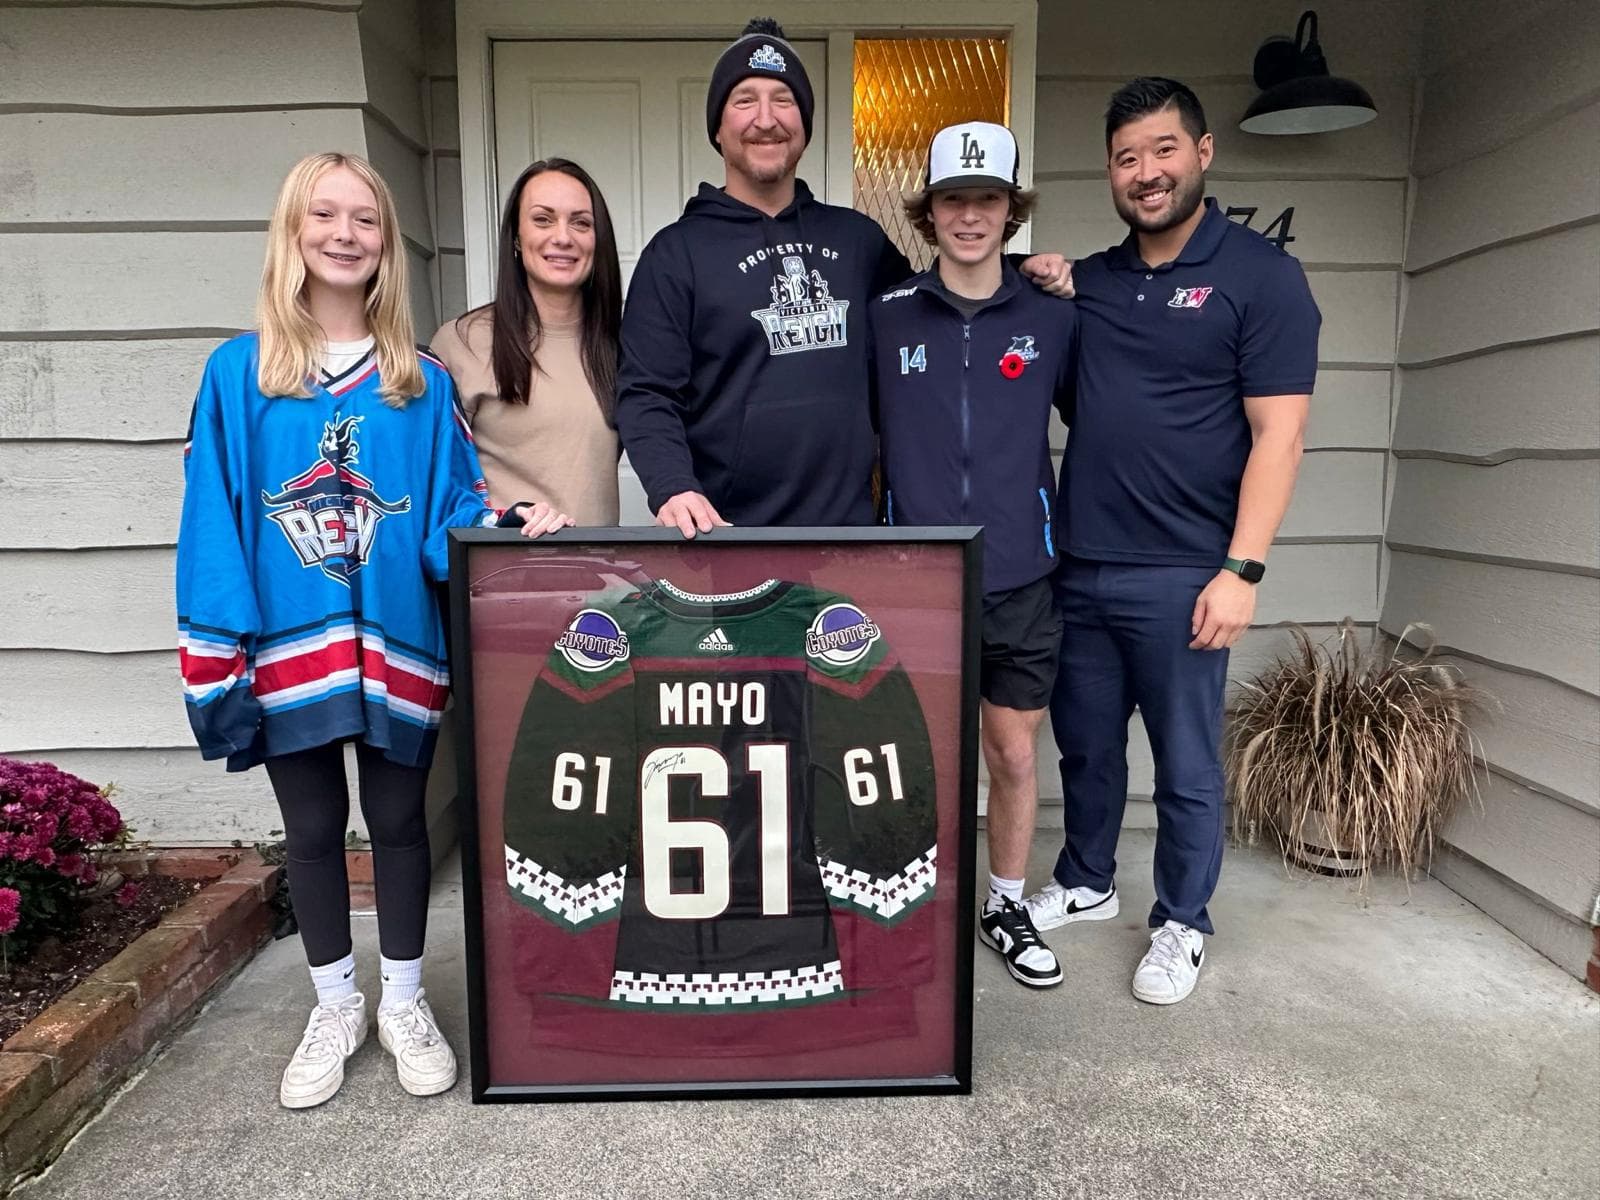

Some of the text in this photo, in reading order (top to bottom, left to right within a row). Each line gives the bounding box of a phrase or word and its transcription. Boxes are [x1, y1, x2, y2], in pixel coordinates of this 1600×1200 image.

[960, 132, 985, 169] LA
[821, 247, 840, 261] OF
[764, 303, 847, 352] REIGN
[899, 344, 927, 375] 14
[698, 641, 734, 651] adidas
[805, 615, 879, 656] COYOTES
[658, 681, 766, 727] MAYO
[551, 752, 612, 815] 61
[842, 742, 904, 807] 61
[640, 742, 790, 921] 61
